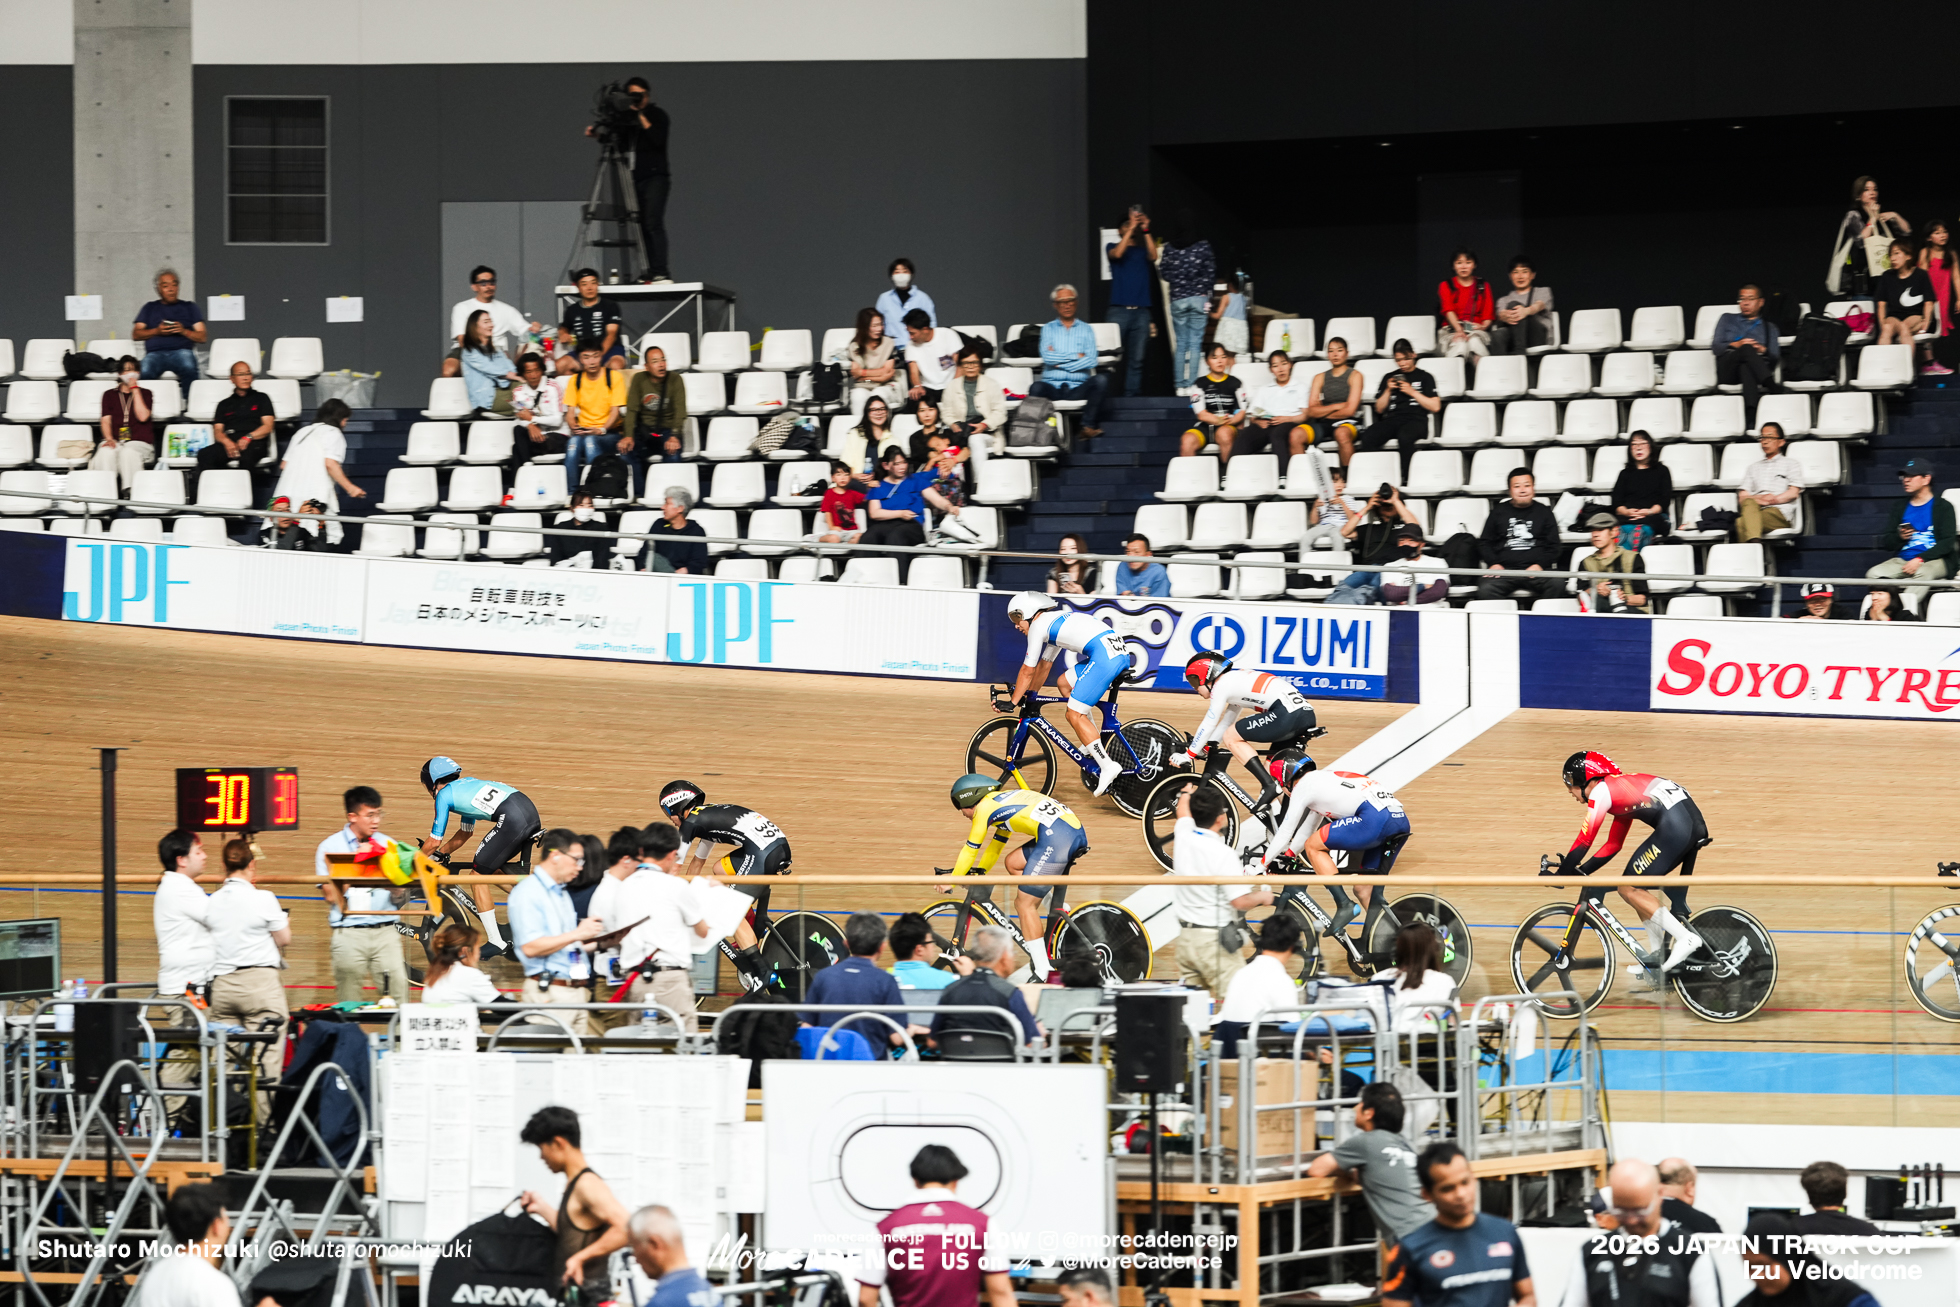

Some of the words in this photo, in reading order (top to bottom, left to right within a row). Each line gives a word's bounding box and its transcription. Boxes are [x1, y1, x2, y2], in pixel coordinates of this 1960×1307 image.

[62, 544, 190, 622] JPF
[470, 588, 567, 607] 自転車競技を
[273, 621, 299, 633] Japan
[301, 623, 328, 634] Photo
[331, 624, 358, 636] Finish
[666, 582, 795, 663] JPF
[575, 641, 602, 651] Japan
[603, 642, 628, 652] Photo
[631, 644, 657, 655] Finish
[1261, 616, 1371, 668] IZUMI
[881, 659, 909, 671] Japan
[911, 660, 939, 672] Photo
[942, 662, 969, 674] Finish
[1656, 638, 1810, 699] SOYO
[1823, 666, 1960, 712] TYRE
[1246, 712, 1277, 730] JAPAN
[1035, 717, 1083, 761] PINARELLO
[204, 774, 250, 825] 30
[483, 788, 499, 802] 5
[959, 791, 973, 799] SMITH
[1038, 801, 1060, 816] 35
[755, 822, 776, 838] 39
[1632, 843, 1662, 875] CHINA
[449, 887, 478, 914] ARGO
[981, 902, 1024, 942] ARGON
[1588, 897, 1646, 954] LOOK
